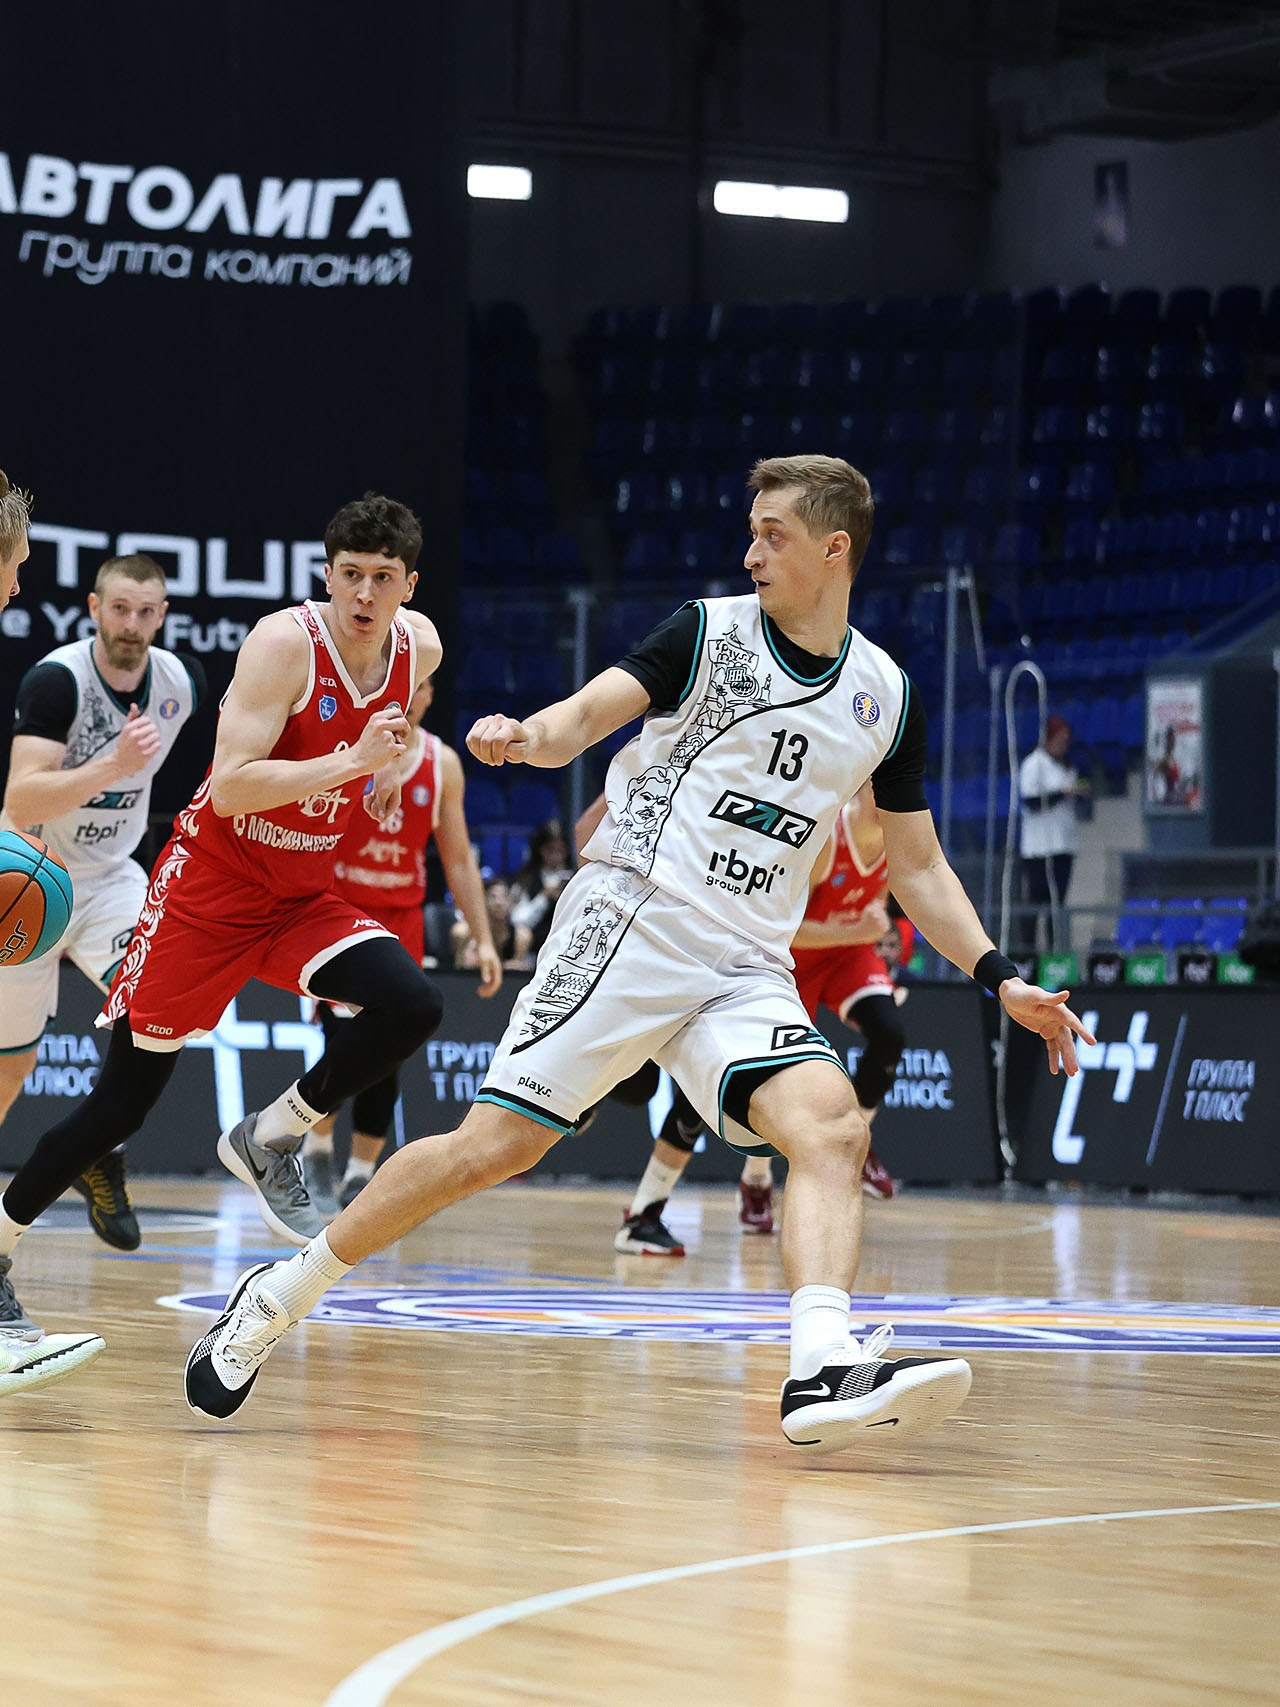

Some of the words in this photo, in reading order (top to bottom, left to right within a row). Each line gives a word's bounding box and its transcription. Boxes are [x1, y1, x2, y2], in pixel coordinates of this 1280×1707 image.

[205, 247, 412, 288] компаний
[766, 728, 809, 782] 13
[705, 875, 742, 897] group
[1187, 1057, 1256, 1090] ГРУППА
